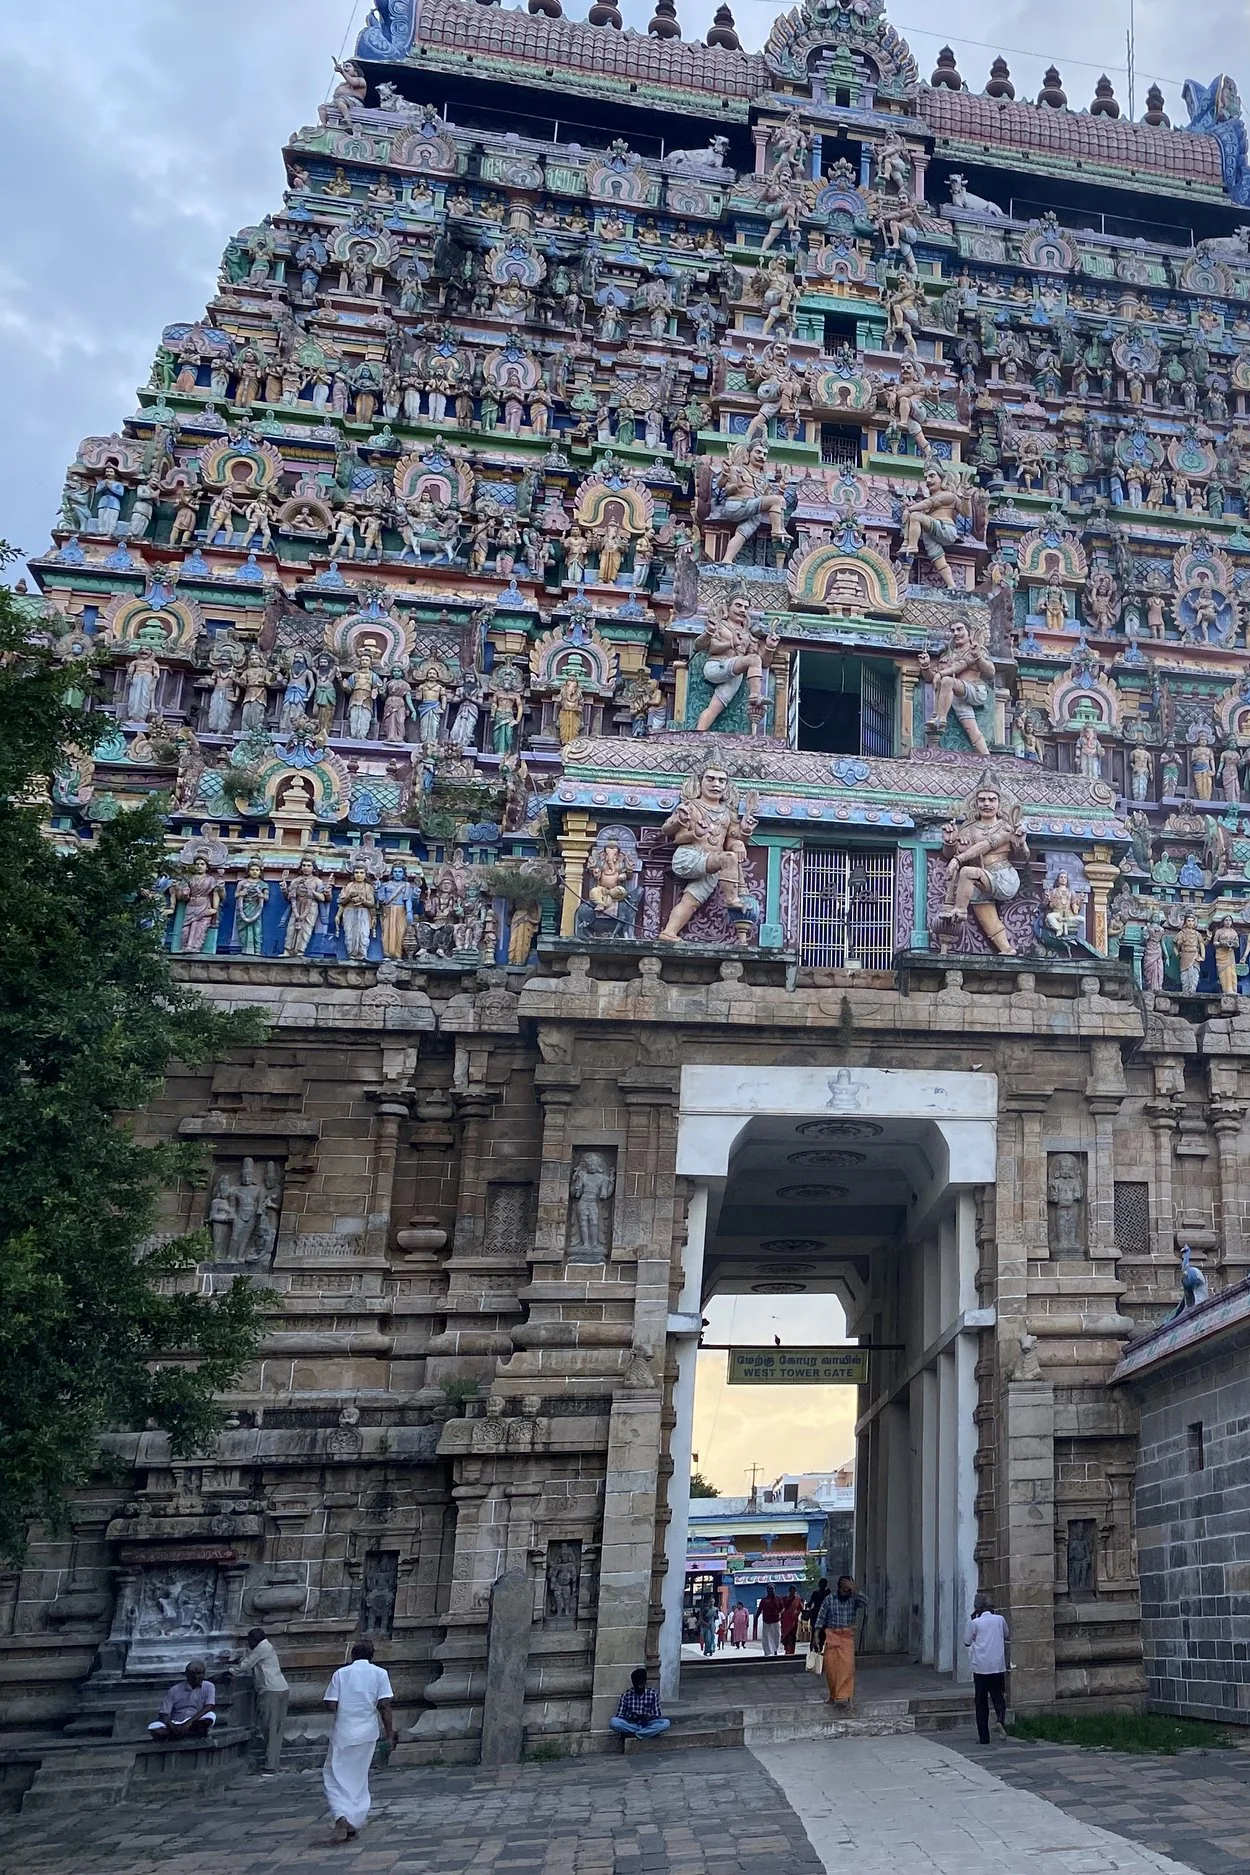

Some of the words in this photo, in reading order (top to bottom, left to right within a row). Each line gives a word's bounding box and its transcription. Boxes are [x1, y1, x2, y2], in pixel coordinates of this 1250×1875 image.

[737, 1354, 775, 1367] மேற்கு
[779, 1355, 818, 1367] கோபுர
[821, 1354, 861, 1366] வாயில்
[743, 1368, 776, 1377] WEST
[780, 1368, 820, 1378] TOWER
[824, 1368, 853, 1378] GATE
